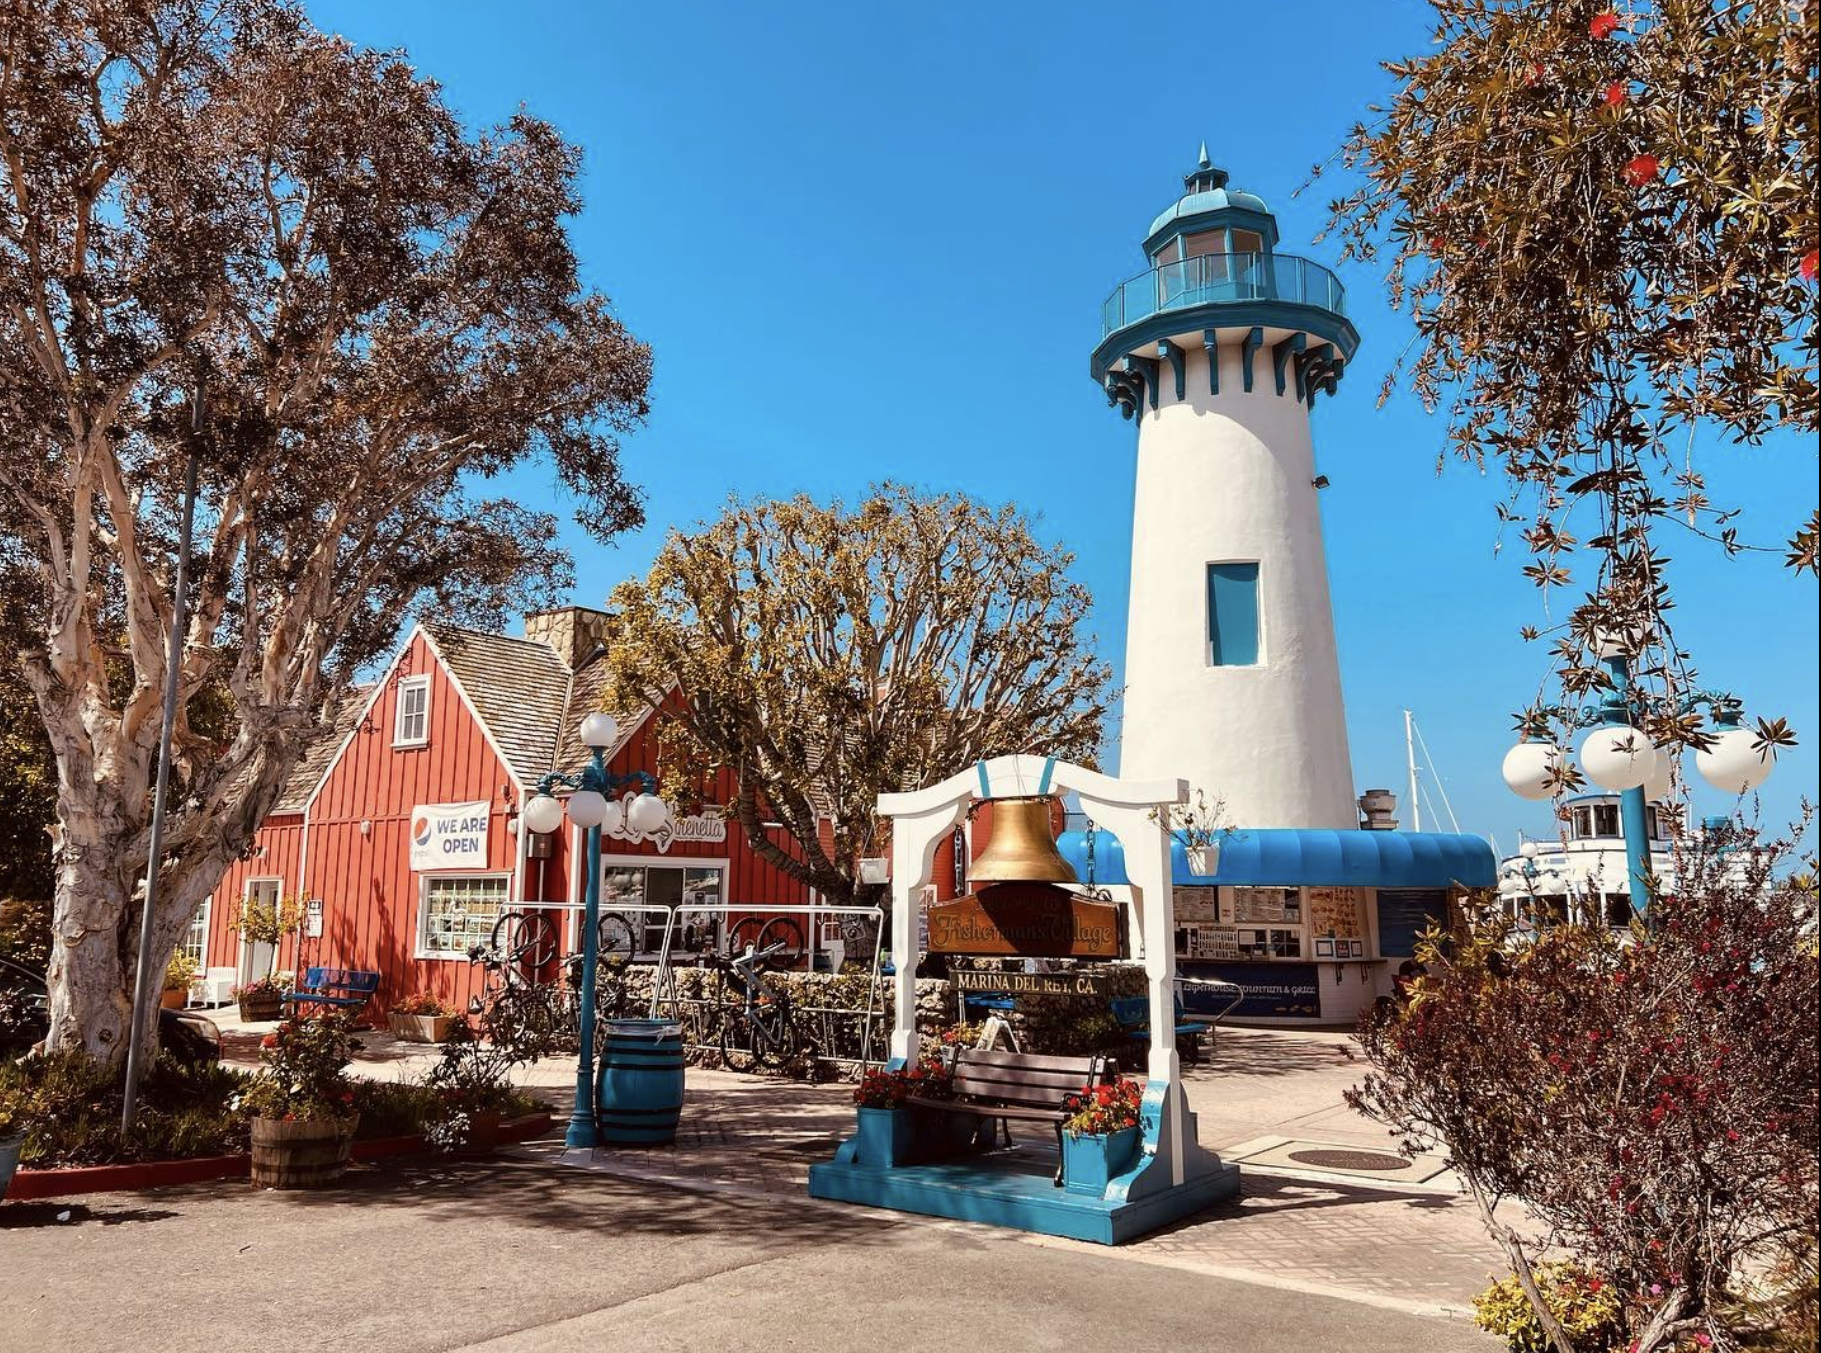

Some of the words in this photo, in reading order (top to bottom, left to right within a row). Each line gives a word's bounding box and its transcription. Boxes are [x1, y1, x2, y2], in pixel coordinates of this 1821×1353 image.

[437, 819, 458, 834] WE
[460, 816, 487, 832] ARE
[443, 837, 479, 854] OPEN
[1041, 913, 1111, 950] Village
[957, 973, 1010, 990] MARINA
[1015, 976, 1039, 991] DEL
[1076, 978, 1098, 994] CA.
